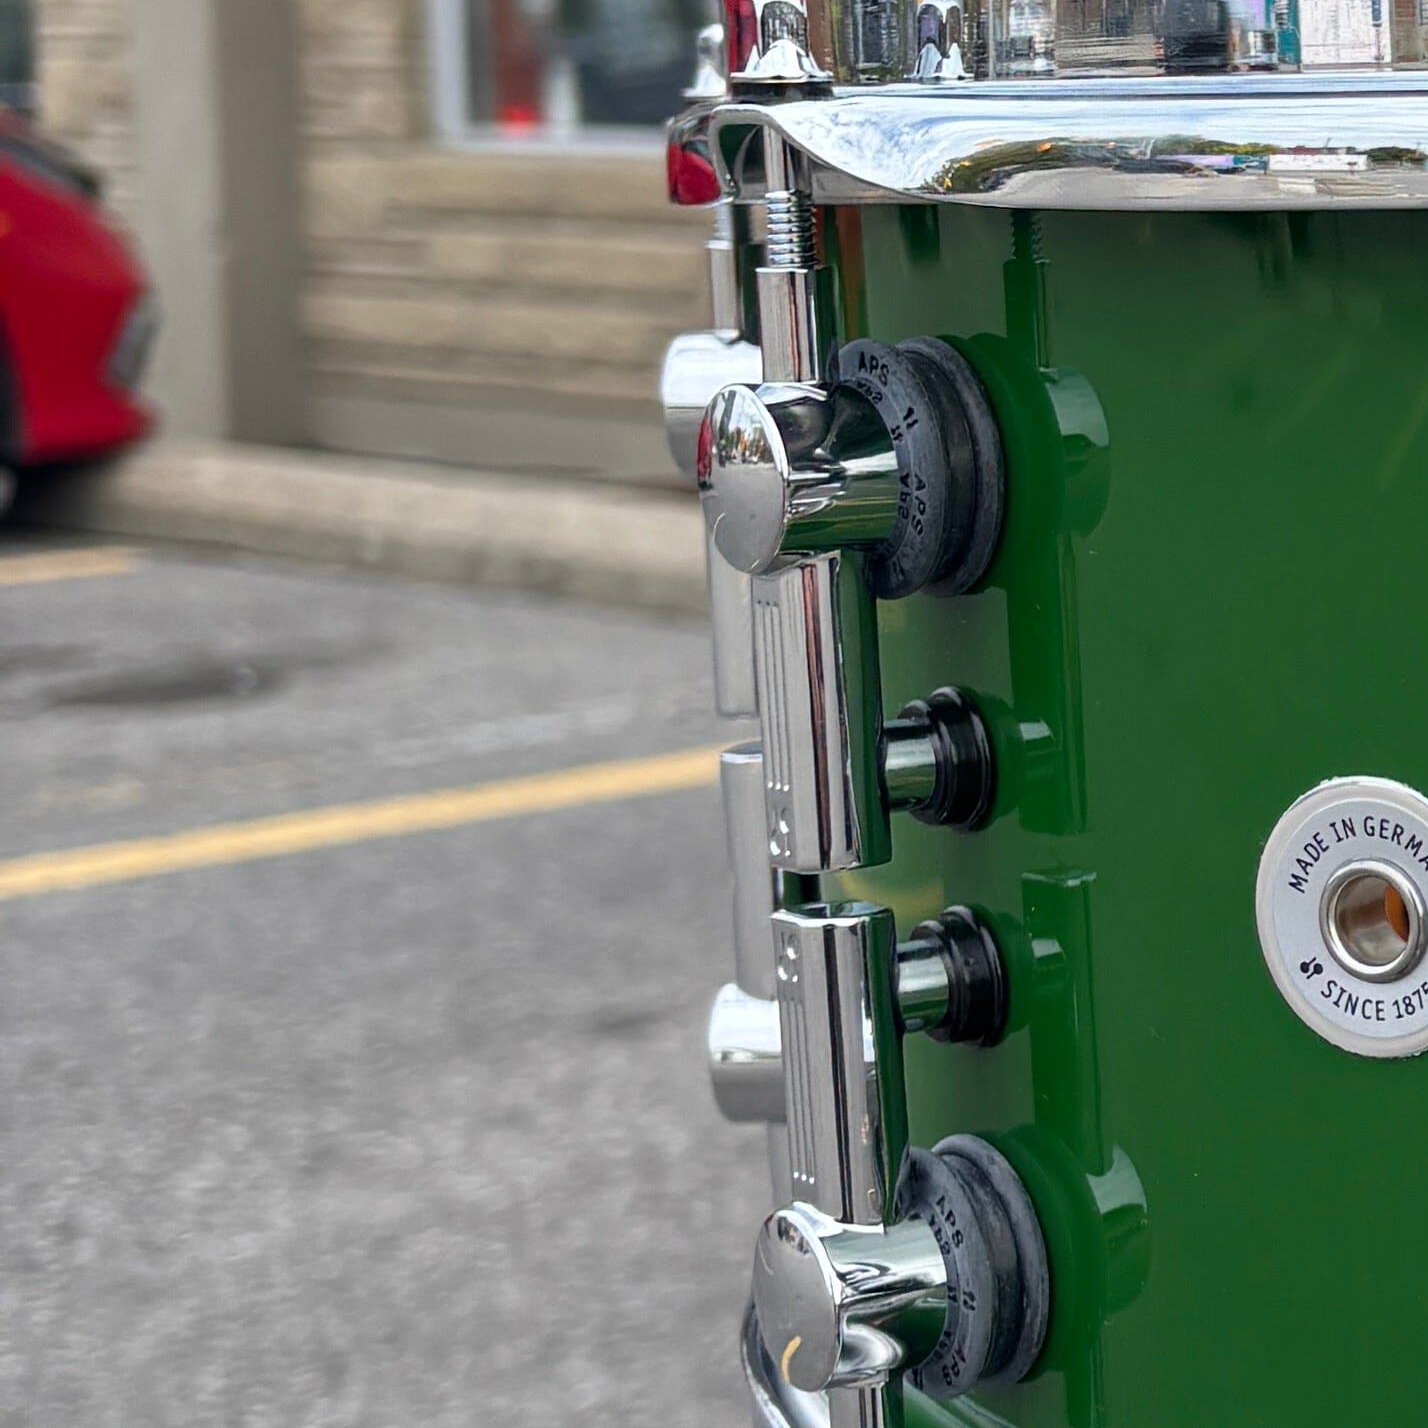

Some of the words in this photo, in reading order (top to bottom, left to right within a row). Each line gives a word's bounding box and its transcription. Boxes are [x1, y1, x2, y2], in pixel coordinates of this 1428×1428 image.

[858, 351, 889, 387] APS
[912, 474, 926, 536] APS
[1288, 832, 1329, 894] MADE
[1329, 817, 1356, 843] IN
[1320, 980, 1386, 1022] SINCE
